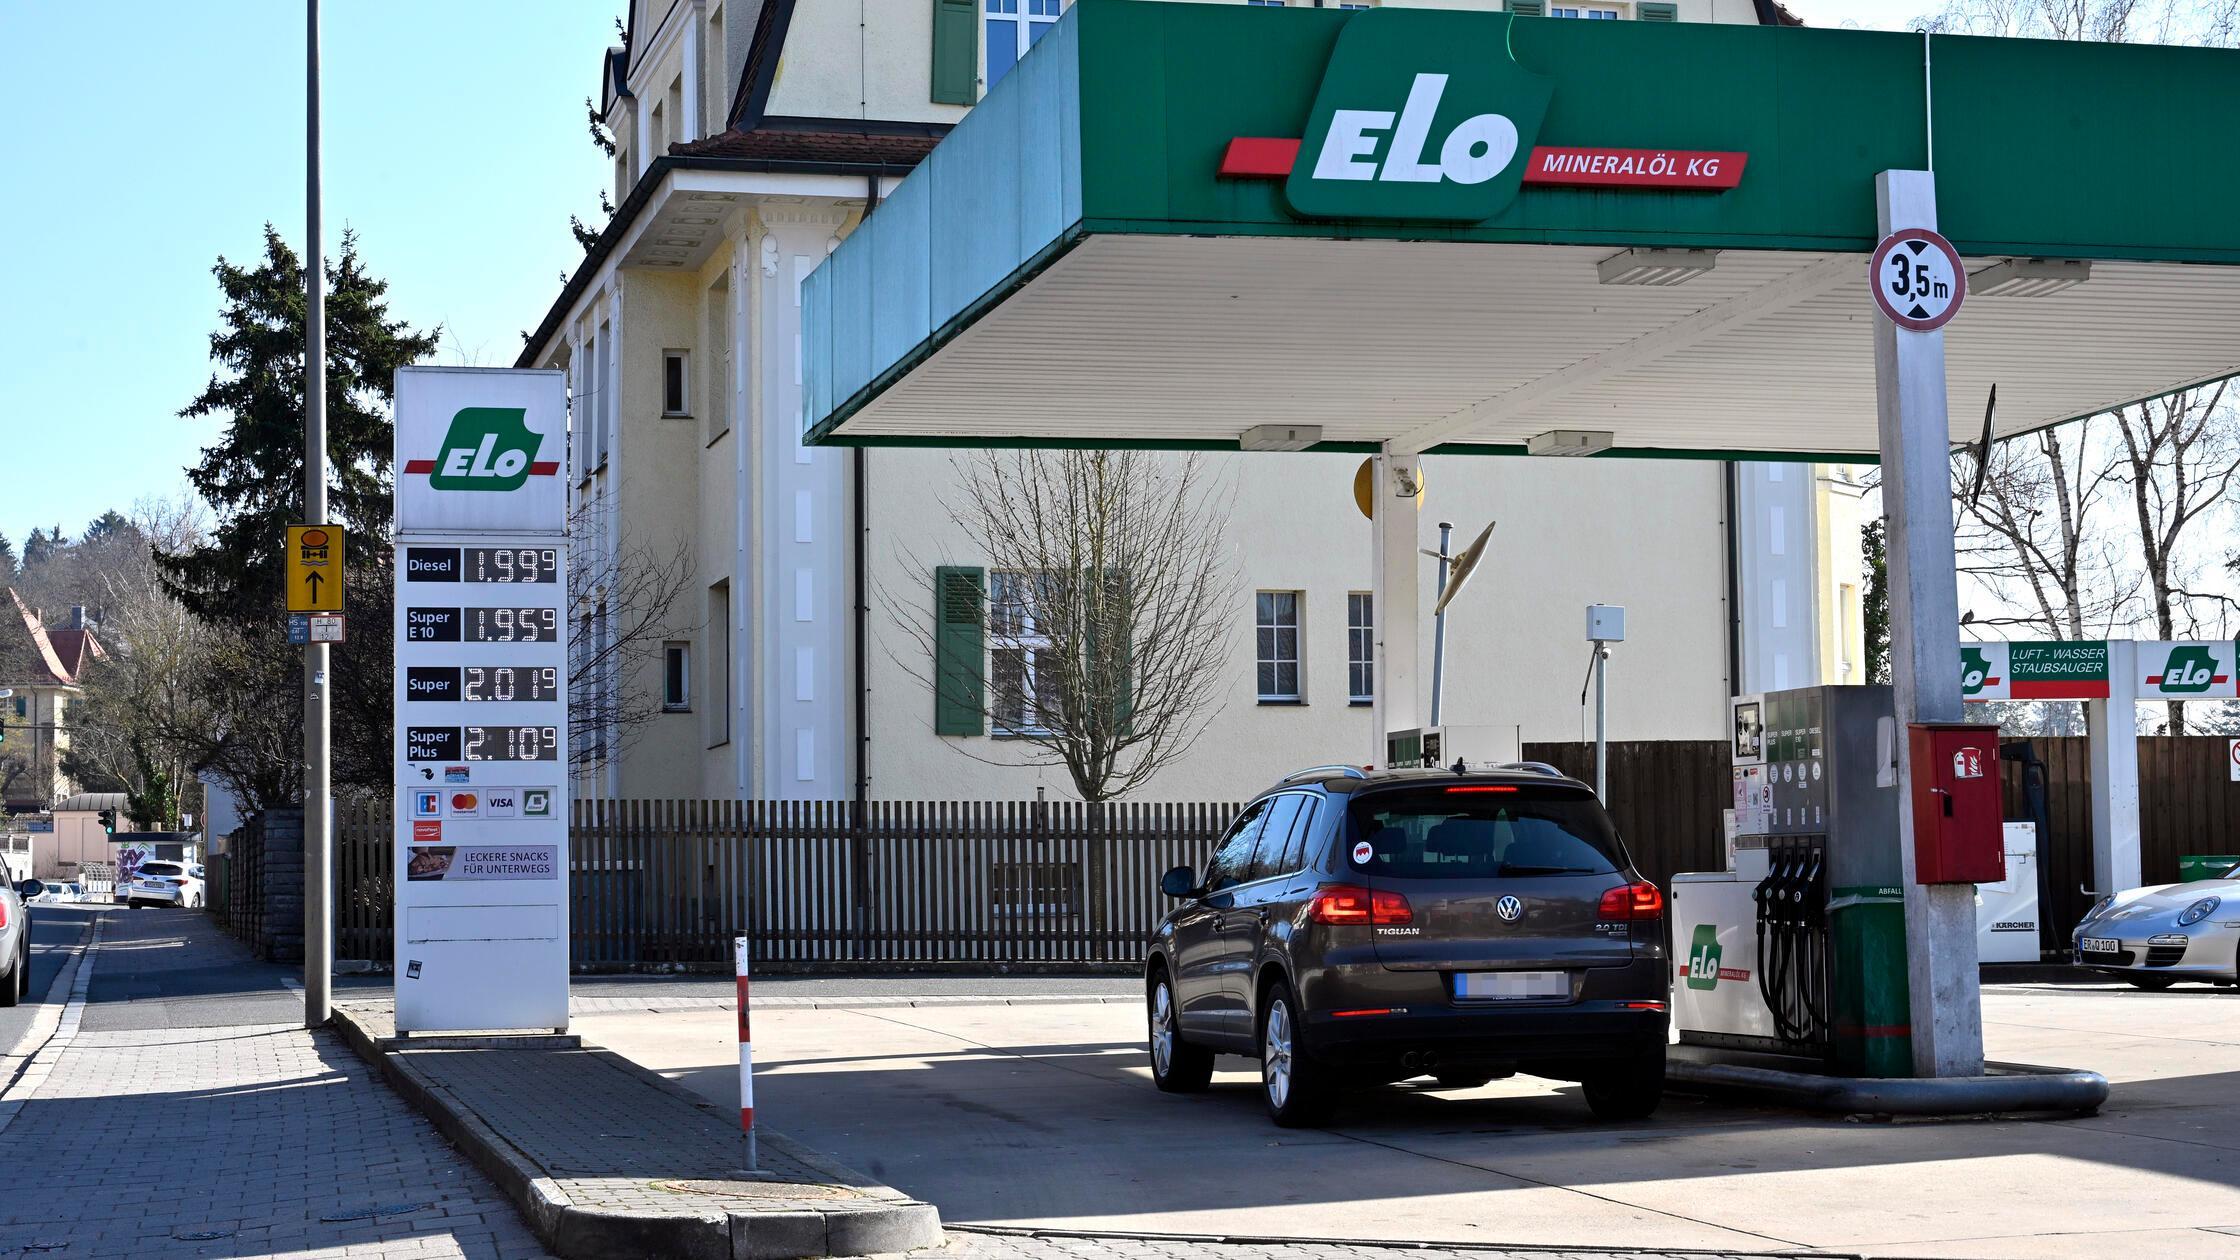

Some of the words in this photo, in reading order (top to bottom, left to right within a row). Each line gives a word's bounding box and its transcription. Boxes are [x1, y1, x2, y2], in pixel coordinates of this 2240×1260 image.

[1542, 153, 1677, 176] MINERALÖL
[1686, 158, 1720, 177] KG
[1891, 253, 1930, 302] 3,5
[1933, 282, 1948, 298] m
[409, 559, 451, 571] Diesel
[478, 550, 555, 582] 1.999
[409, 611, 450, 625] Super
[410, 628, 417, 638] E
[420, 628, 434, 638] 10
[478, 609, 556, 641] 1.959
[2012, 649, 2044, 660] LUFT
[2053, 648, 2106, 660] WASSER
[2011, 662, 2104, 674] STAUBSAUGER
[409, 679, 450, 693] Super
[465, 668, 556, 701] 2.019
[409, 731, 450, 745] Super
[410, 746, 437, 758] Plus
[465, 727, 556, 760] 2.109
[490, 798, 513, 808] VISA
[465, 852, 507, 862] LECKERE
[510, 852, 549, 861] SNACKS
[463, 863, 484, 874] FÜR
[486, 864, 550, 874] UNTERWEGS
[1878, 887, 1902, 895] ABFALL
[1376, 927, 1420, 935] TIGUAN
[1612, 923, 1628, 931] TDI
[2101, 940, 2116, 952] 100
